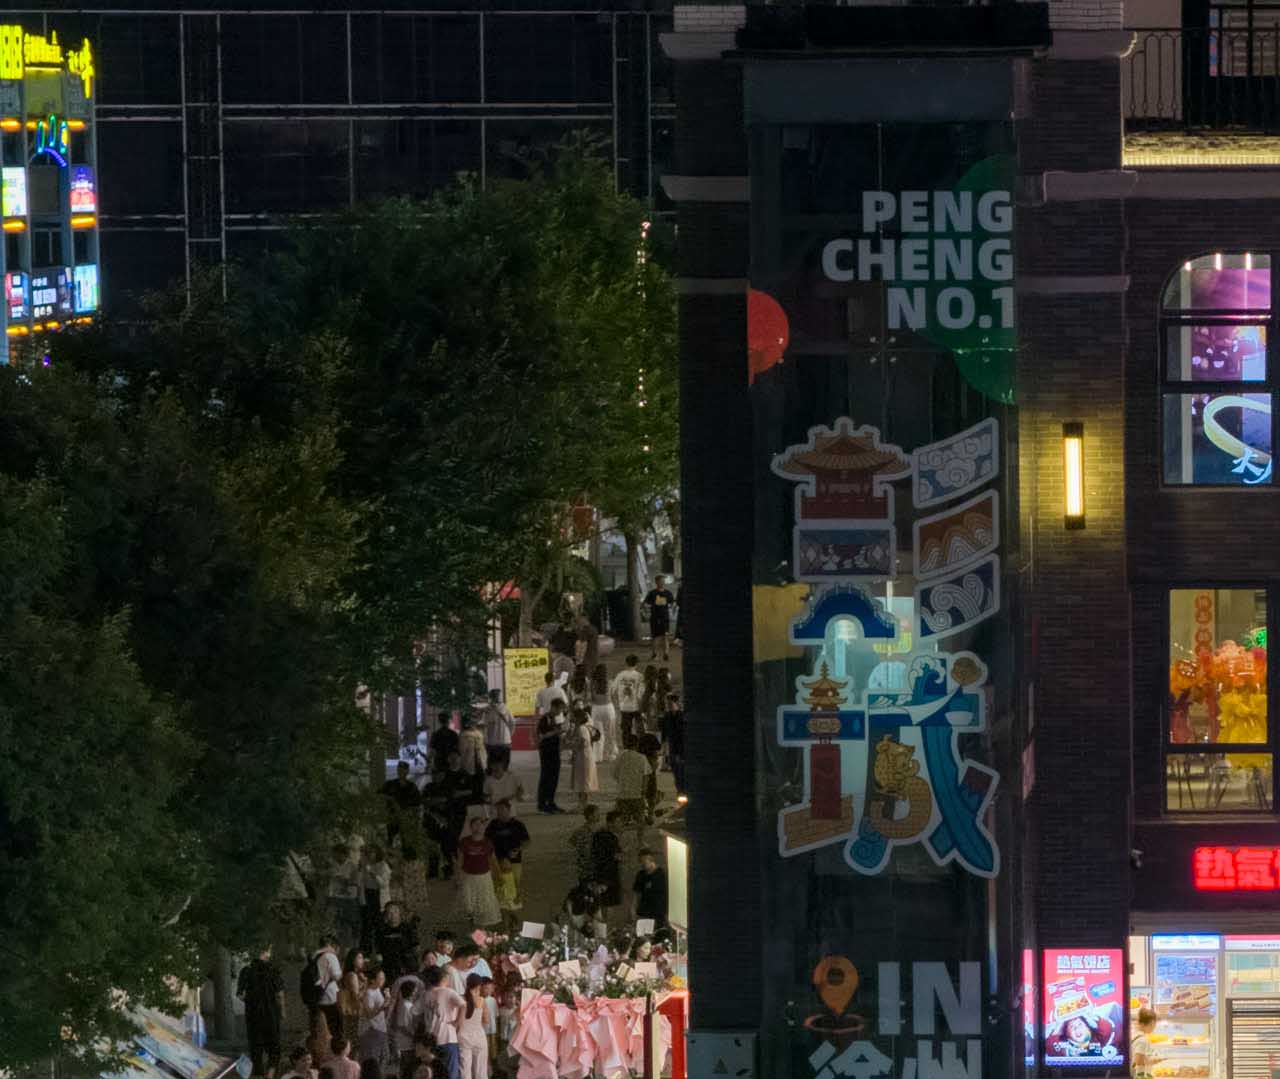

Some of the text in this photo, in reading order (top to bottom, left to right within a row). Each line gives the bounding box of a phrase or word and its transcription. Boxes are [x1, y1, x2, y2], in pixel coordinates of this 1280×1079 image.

[862, 191, 1014, 233] PENG
[822, 239, 1014, 283] CHENG
[888, 287, 1014, 330] NO.1
[878, 961, 982, 1036] IN
